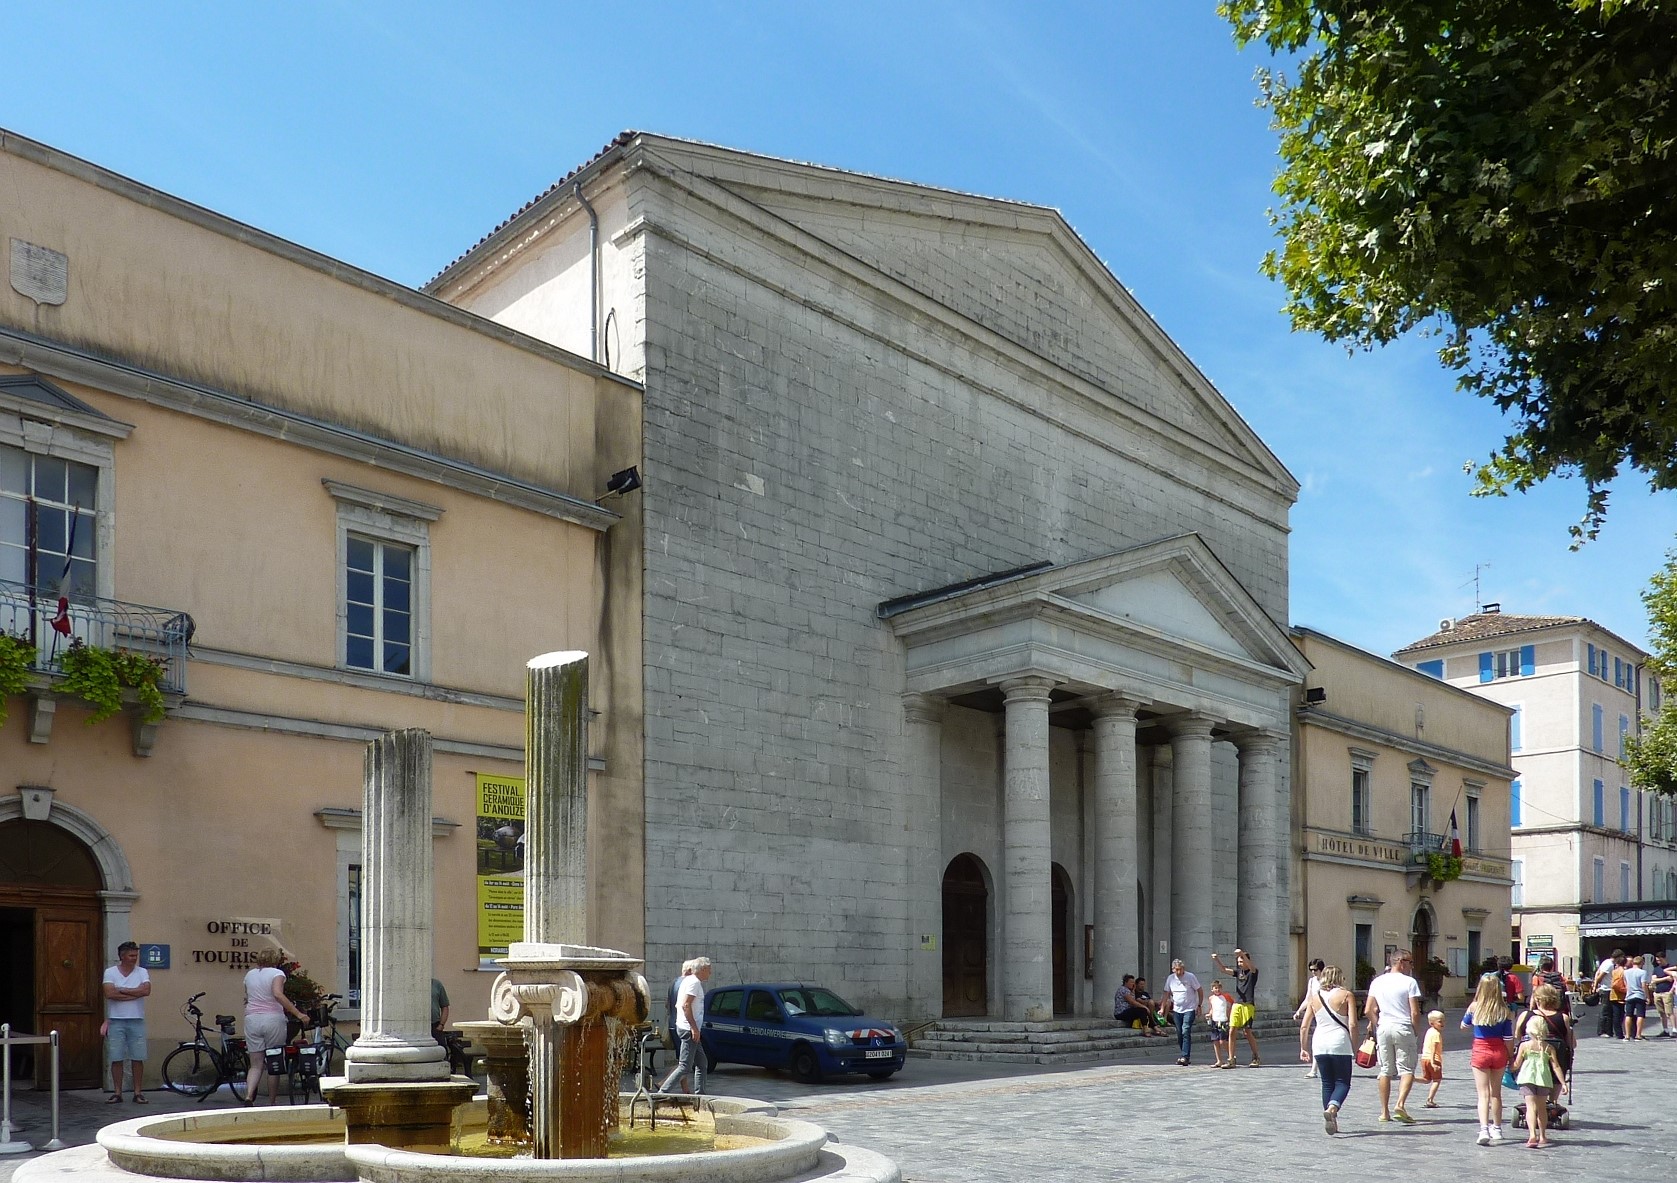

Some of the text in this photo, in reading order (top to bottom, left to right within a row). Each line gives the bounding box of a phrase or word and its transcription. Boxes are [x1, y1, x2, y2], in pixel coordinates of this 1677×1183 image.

[483, 782, 520, 797] FESTIVAL
[483, 793, 525, 807] CERAMIQUE
[1321, 837, 1401, 861] HÔTEL DE VILLE
[206, 920, 272, 935] OFFICE
[1585, 928, 1618, 936] BRASSERIE
[231, 938, 249, 948] DE
[192, 950, 259, 964] TOURIS
